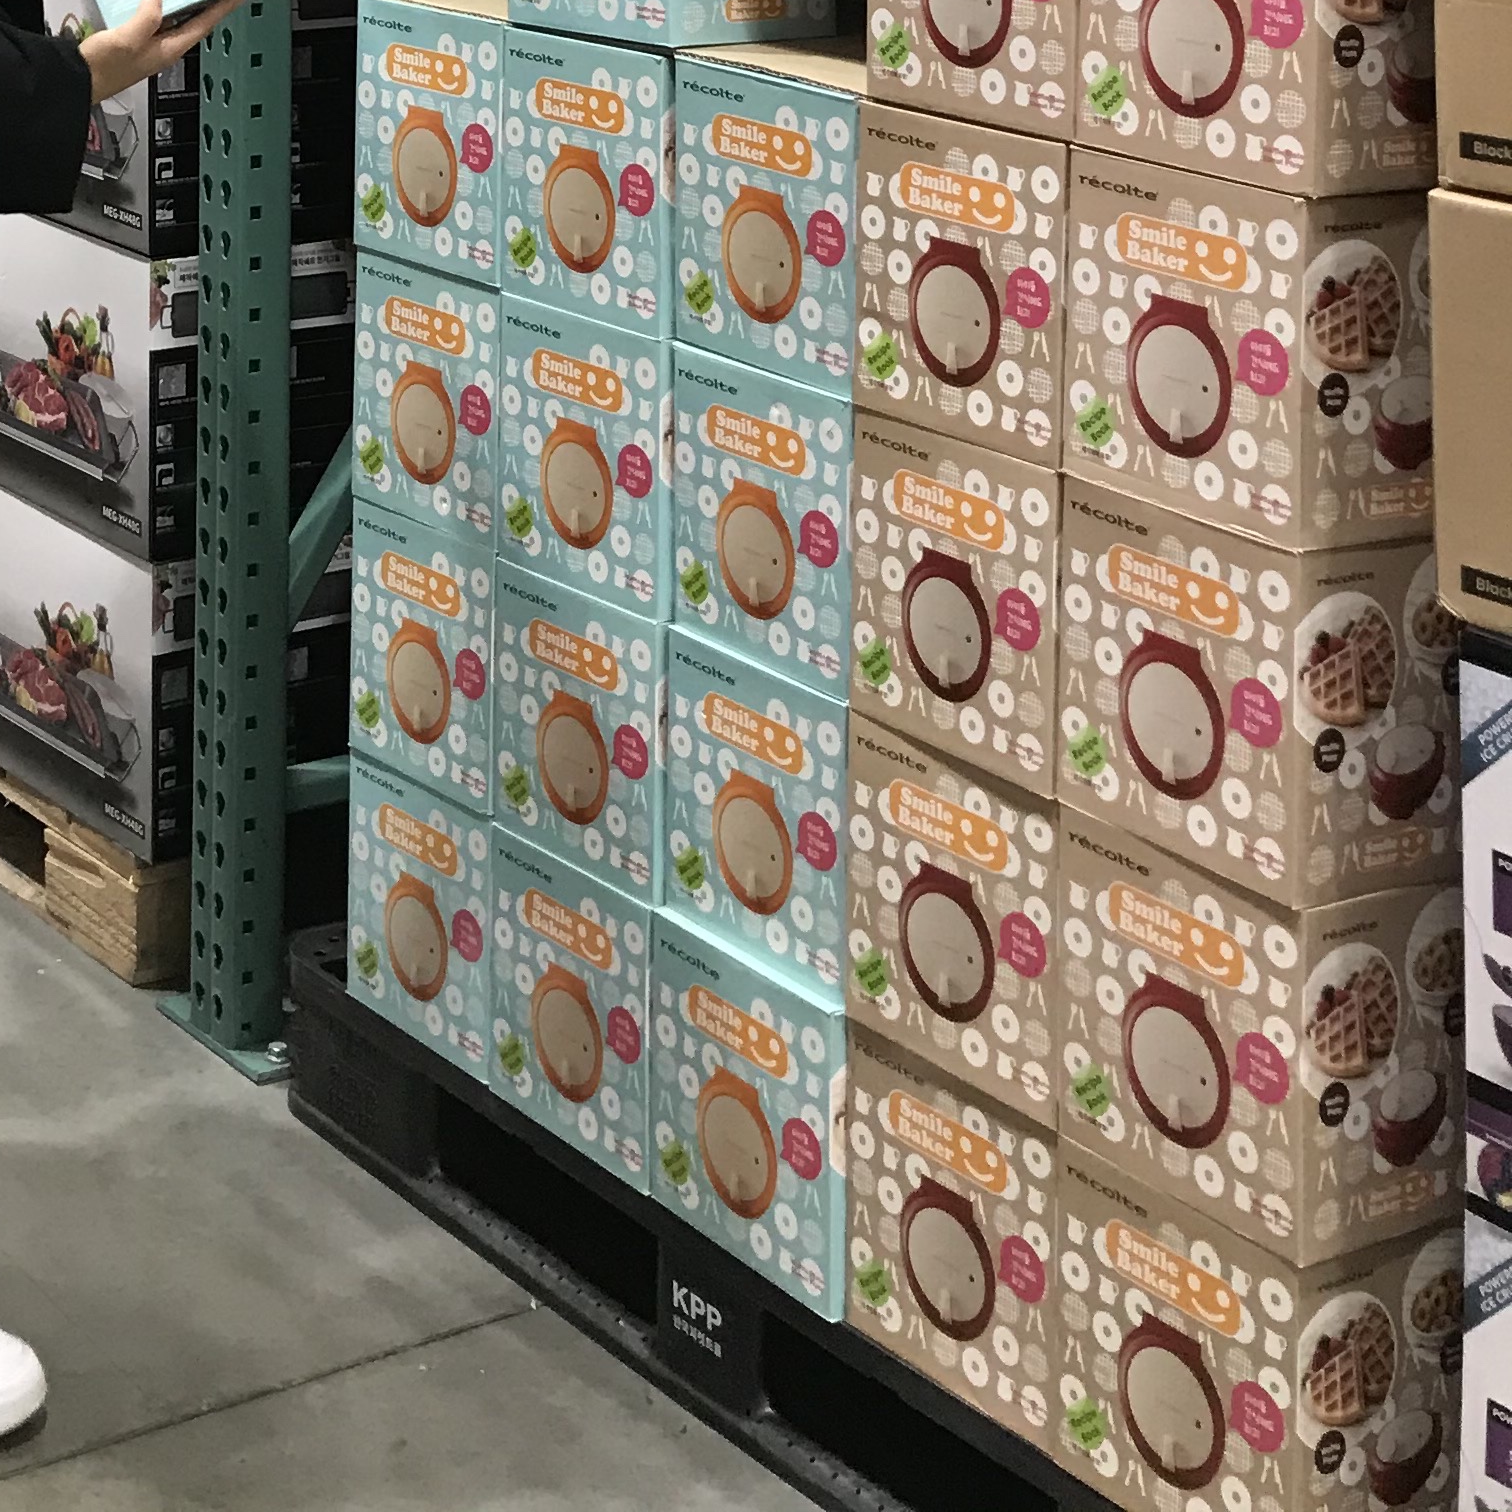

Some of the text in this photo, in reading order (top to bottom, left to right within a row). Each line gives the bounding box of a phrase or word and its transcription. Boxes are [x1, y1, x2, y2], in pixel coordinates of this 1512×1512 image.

[363, 15, 412, 33] récolte
[394, 48, 430, 69] Smile
[509, 48, 564, 67] récolte
[392, 64, 431, 86] Baker
[543, 83, 584, 107] Smile
[683, 80, 744, 103] récolte
[542, 100, 585, 123] Baker
[721, 119, 767, 145] Smile
[867, 126, 936, 151] récolte
[719, 137, 768, 163] Baker
[910, 168, 961, 196] Smile
[1079, 174, 1158, 200] récolte
[908, 188, 963, 216] Baker
[1128, 220, 1187, 250] Smile
[1126, 242, 1188, 272] Baker
[361, 264, 412, 288] récolte
[392, 301, 429, 325] Smile
[506, 314, 561, 341] récolte
[390, 317, 430, 342] Baker
[540, 354, 581, 382] Smile
[678, 366, 738, 397] récolte
[539, 370, 582, 399] Baker
[715, 410, 760, 441] Smile
[714, 427, 761, 459] Baker
[861, 430, 929, 461] récolte
[903, 476, 953, 508] Smile
[902, 498, 954, 529] Baker
[1071, 500, 1148, 535] récolte
[357, 516, 407, 546] récolte
[387, 556, 425, 584] Smile
[1120, 551, 1179, 587] Smile
[386, 573, 425, 601] Baker
[503, 581, 557, 613] récolte
[1118, 575, 1180, 612] Baker
[537, 624, 577, 656] Smile
[534, 640, 578, 674] Baker
[675, 650, 736, 687] récolte
[713, 698, 758, 734] Smile
[711, 716, 759, 753] Baker
[855, 734, 927, 773] récolte
[355, 765, 405, 798] récolte
[901, 788, 953, 823] Smile
[384, 825, 423, 856] Baker
[385, 810, 422, 840] Smile
[898, 809, 954, 847] Baker
[498, 846, 552, 884] récolte
[1069, 830, 1150, 877] récolte
[533, 894, 573, 930] Smile
[1121, 891, 1181, 933] Smile
[530, 910, 574, 948] Baker
[1119, 912, 1183, 958] Baker
[660, 938, 720, 982] récolte
[698, 990, 743, 1030] Smile
[696, 1006, 744, 1050] Baker
[854, 1039, 924, 1084] récolte
[900, 1099, 953, 1139] Smile
[898, 1118, 955, 1163] Baker
[1067, 1165, 1148, 1218] récolte
[1120, 1228, 1179, 1276] Smile
[1117, 1250, 1181, 1300] Baker
[672, 1280, 723, 1331] KPP
